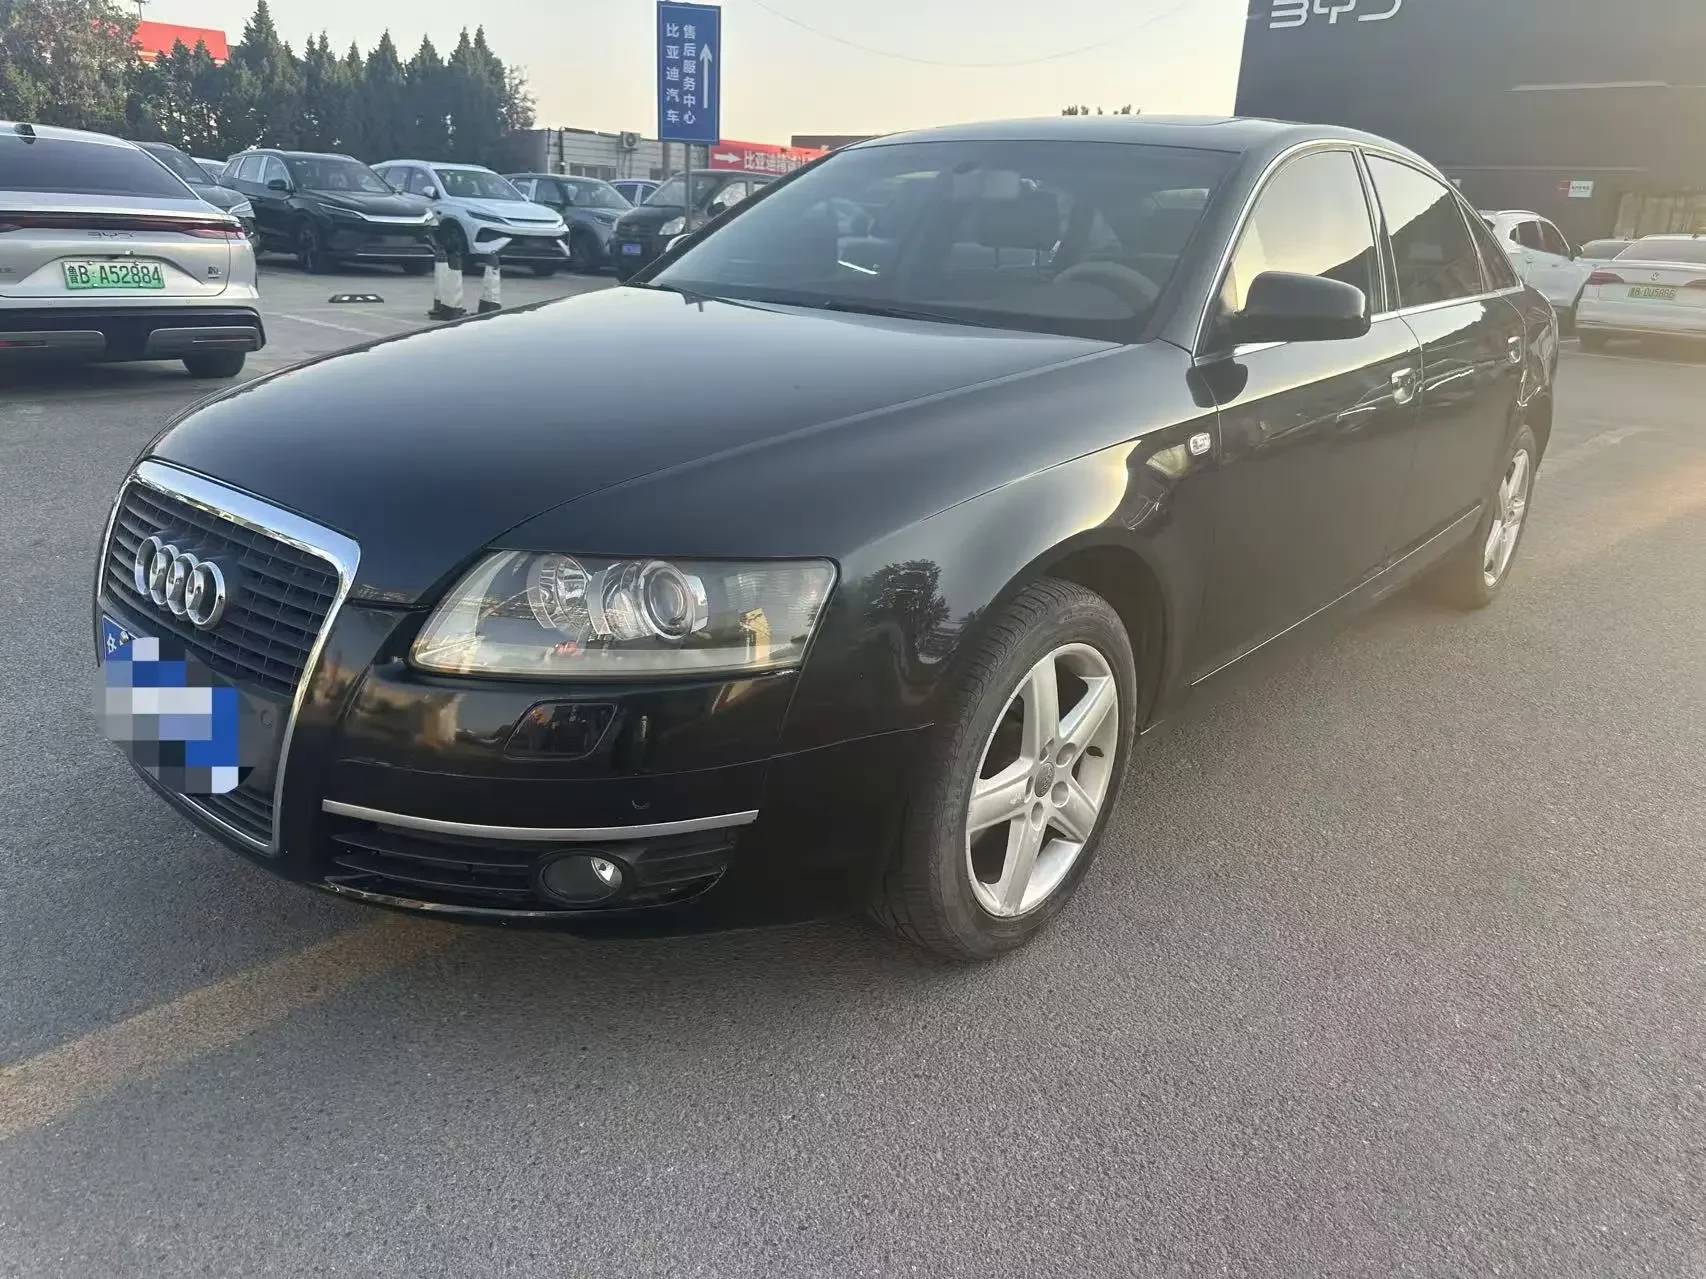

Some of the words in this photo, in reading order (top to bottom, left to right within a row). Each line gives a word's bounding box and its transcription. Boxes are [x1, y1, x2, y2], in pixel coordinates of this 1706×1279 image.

[1269, 0, 1402, 29] BYD
[665, 23, 680, 124] 比亚迪汽车
[683, 24, 697, 125] 售后服务中心
